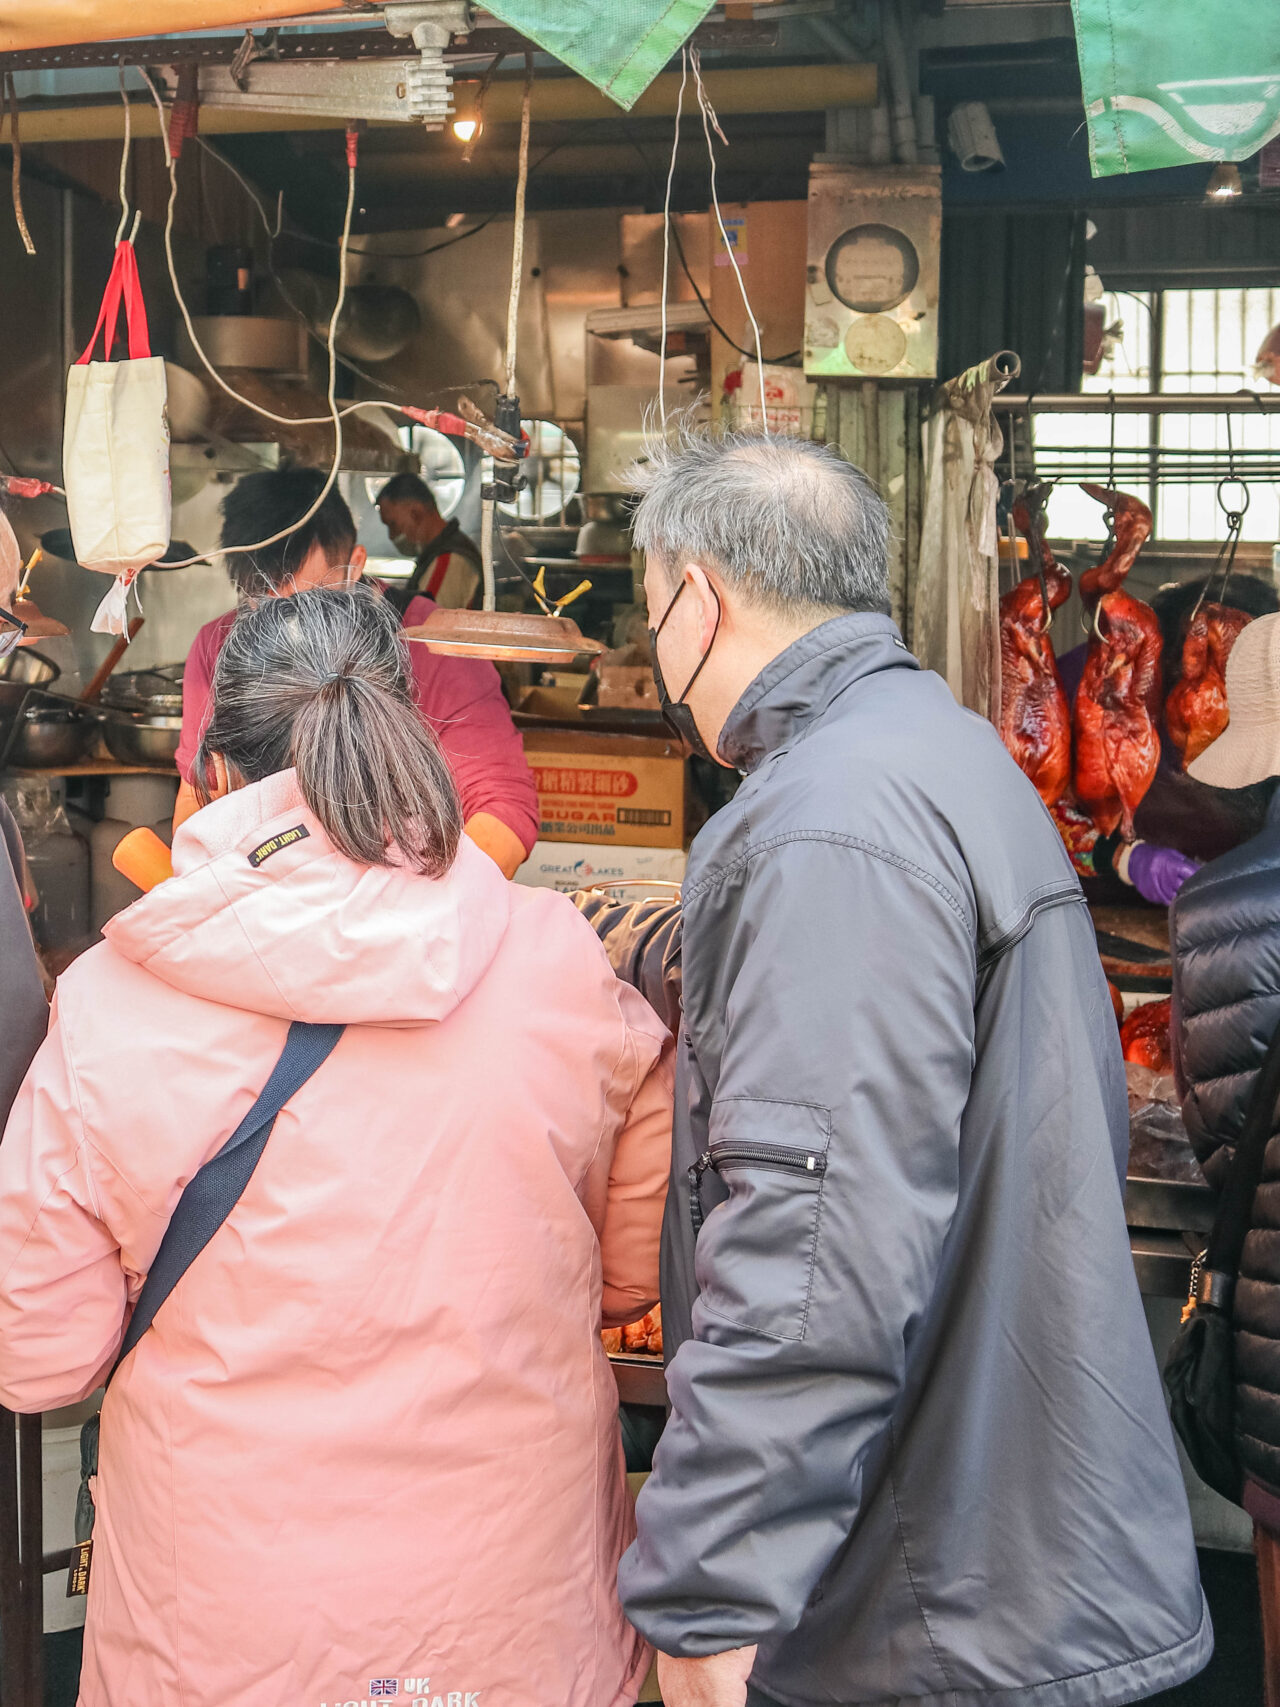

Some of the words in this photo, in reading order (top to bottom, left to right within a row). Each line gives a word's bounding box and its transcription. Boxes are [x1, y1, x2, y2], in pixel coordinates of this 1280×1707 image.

[541, 810, 615, 822] SUGAR
[540, 863, 573, 873] GREAT
[592, 866, 624, 876] LAKES
[404, 1677, 431, 1695] UK
